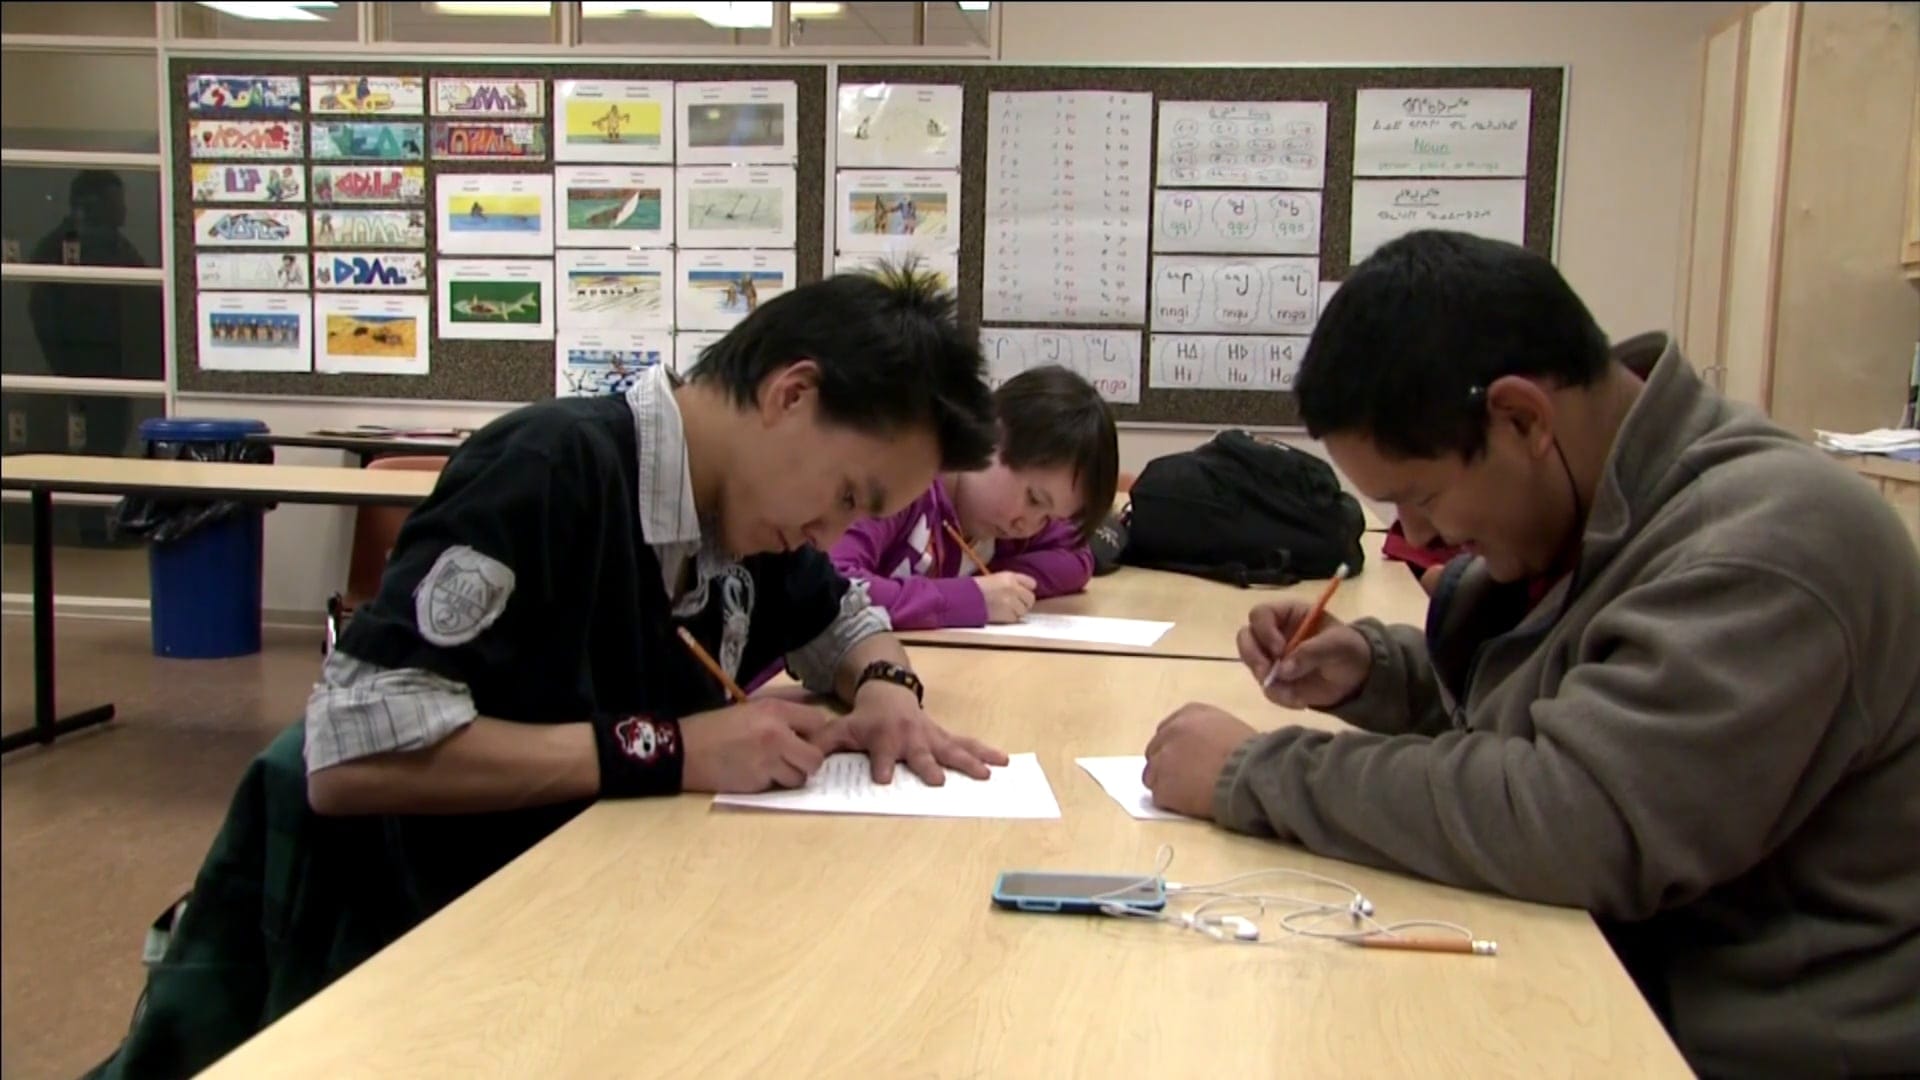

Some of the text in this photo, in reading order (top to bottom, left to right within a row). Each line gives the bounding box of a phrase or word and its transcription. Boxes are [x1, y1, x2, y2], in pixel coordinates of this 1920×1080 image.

[1414, 138, 1449, 153] Noun
[1160, 306, 1189, 324] nngi
[1174, 367, 1193, 383] Hi
[1228, 367, 1248, 383] Hu
